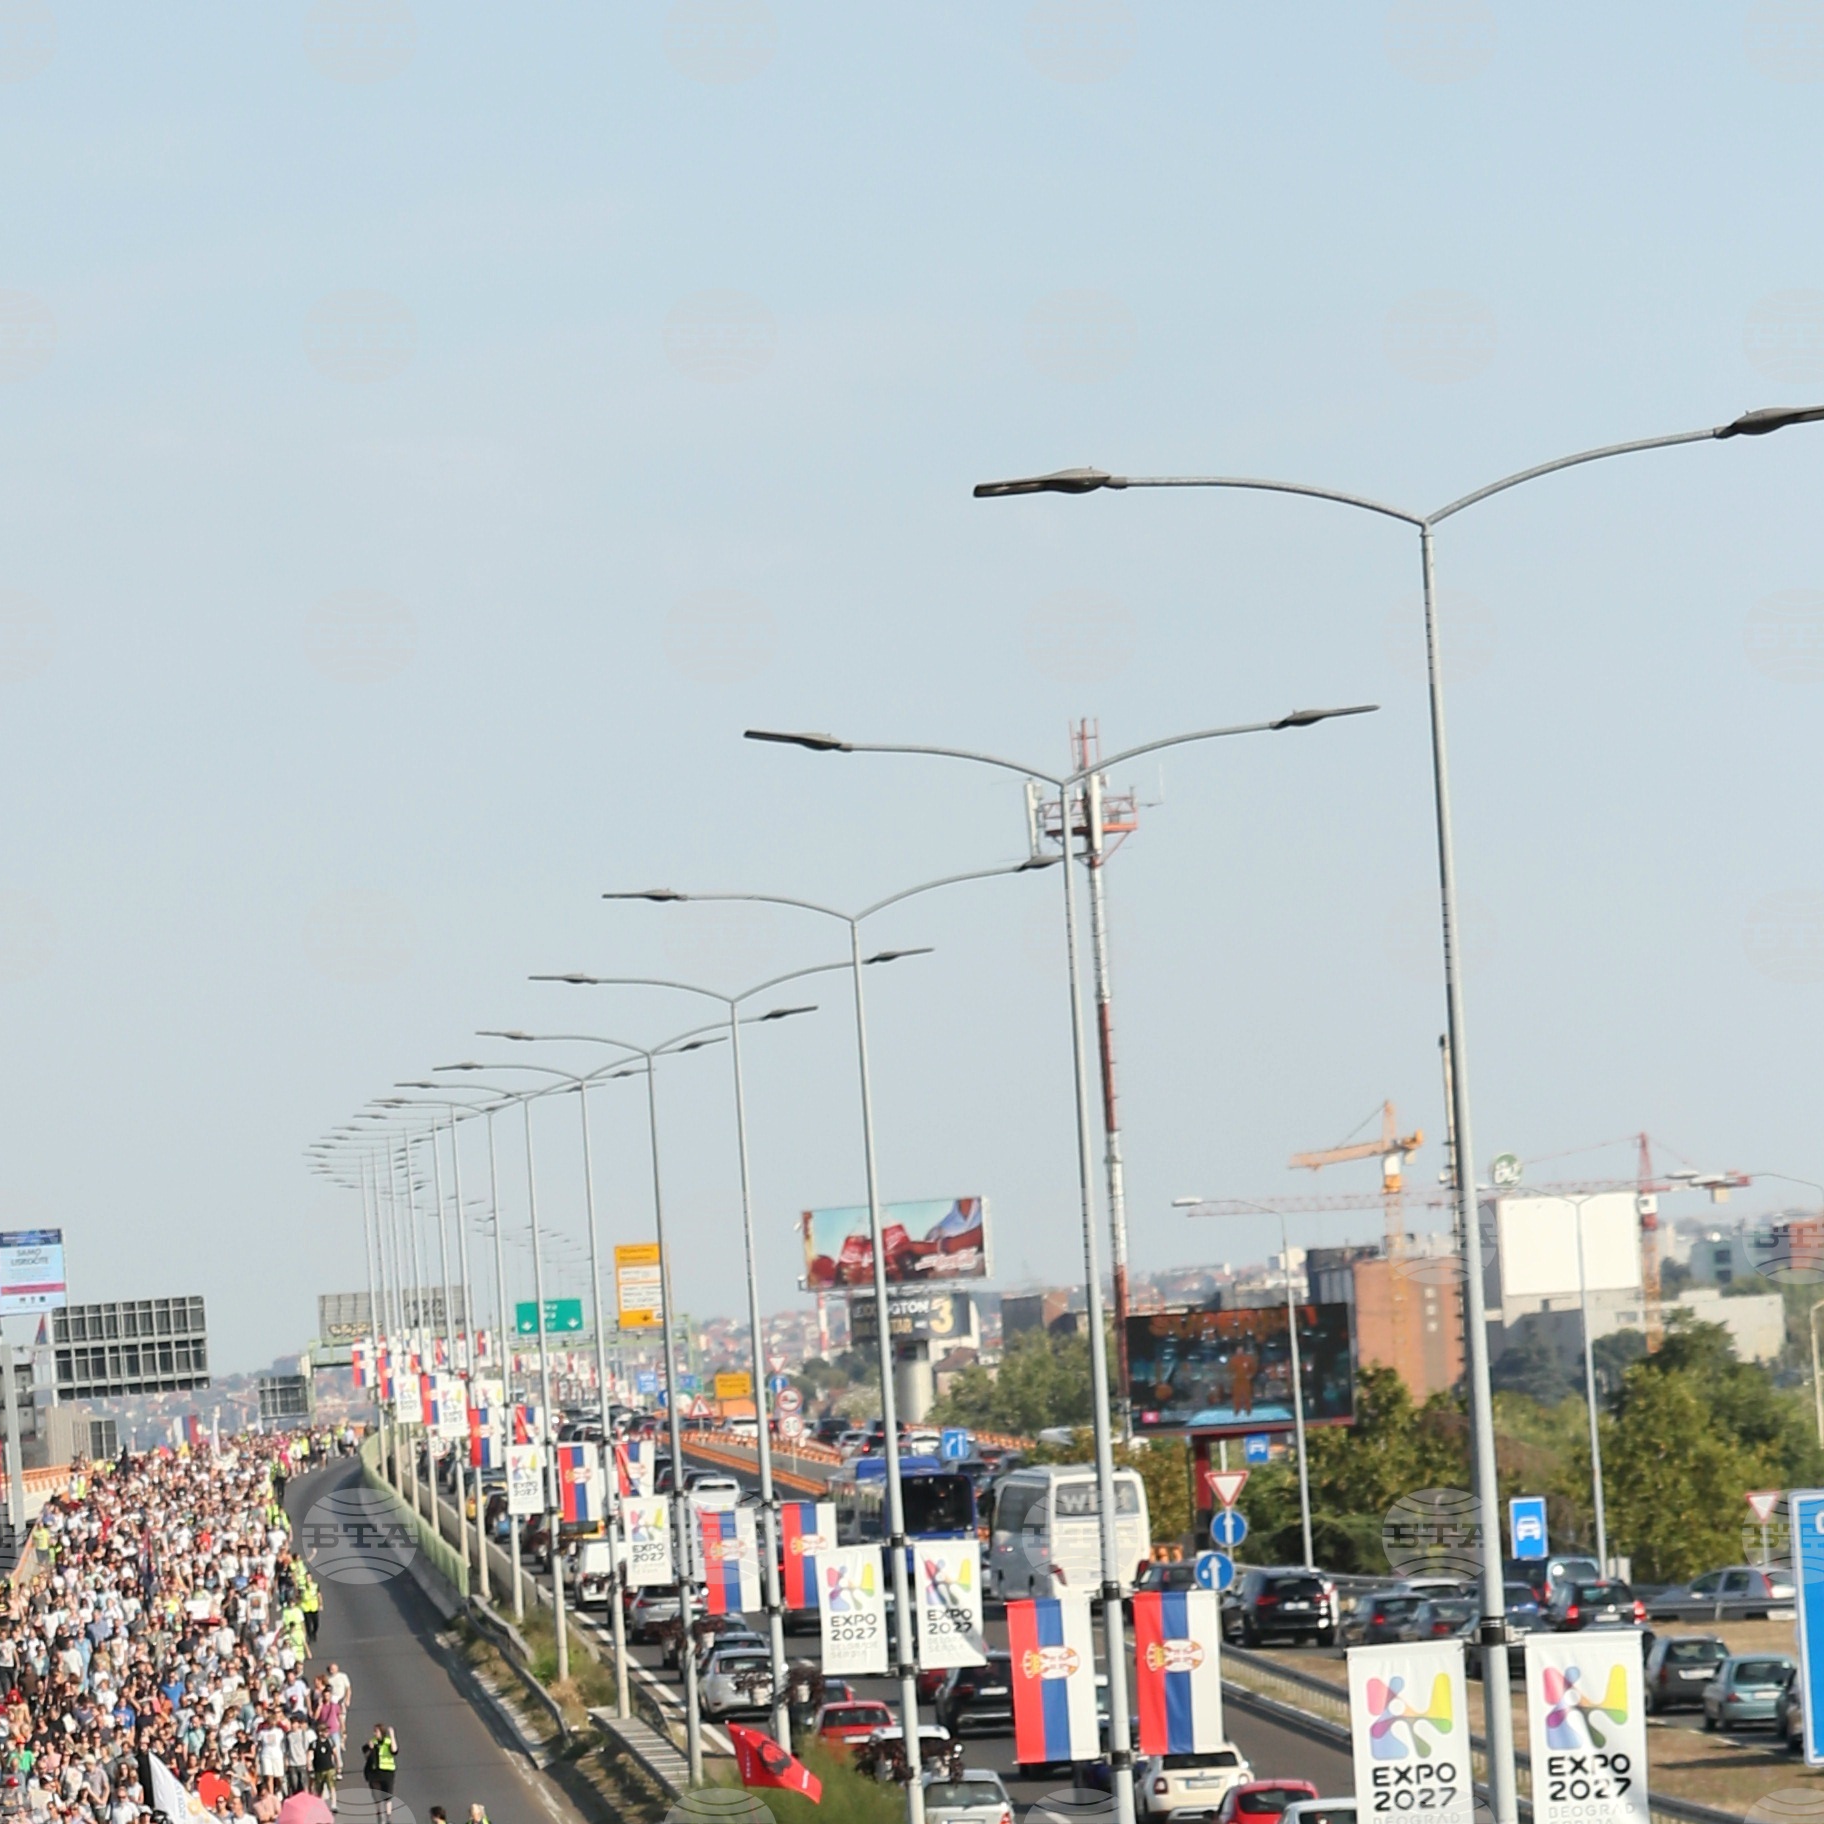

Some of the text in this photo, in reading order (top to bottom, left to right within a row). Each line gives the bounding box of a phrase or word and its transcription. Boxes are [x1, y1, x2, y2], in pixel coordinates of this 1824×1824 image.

[830, 1613, 878, 1628] EXPO
[927, 1609, 973, 1622] EXPO
[831, 1627, 878, 1642] 2027
[928, 1622, 973, 1635] 2027
[1547, 1753, 1632, 1778] EXPO
[1370, 1763, 1456, 1790] EXPO
[1548, 1777, 1632, 1803] 2027
[1372, 1788, 1457, 1813] 2027
